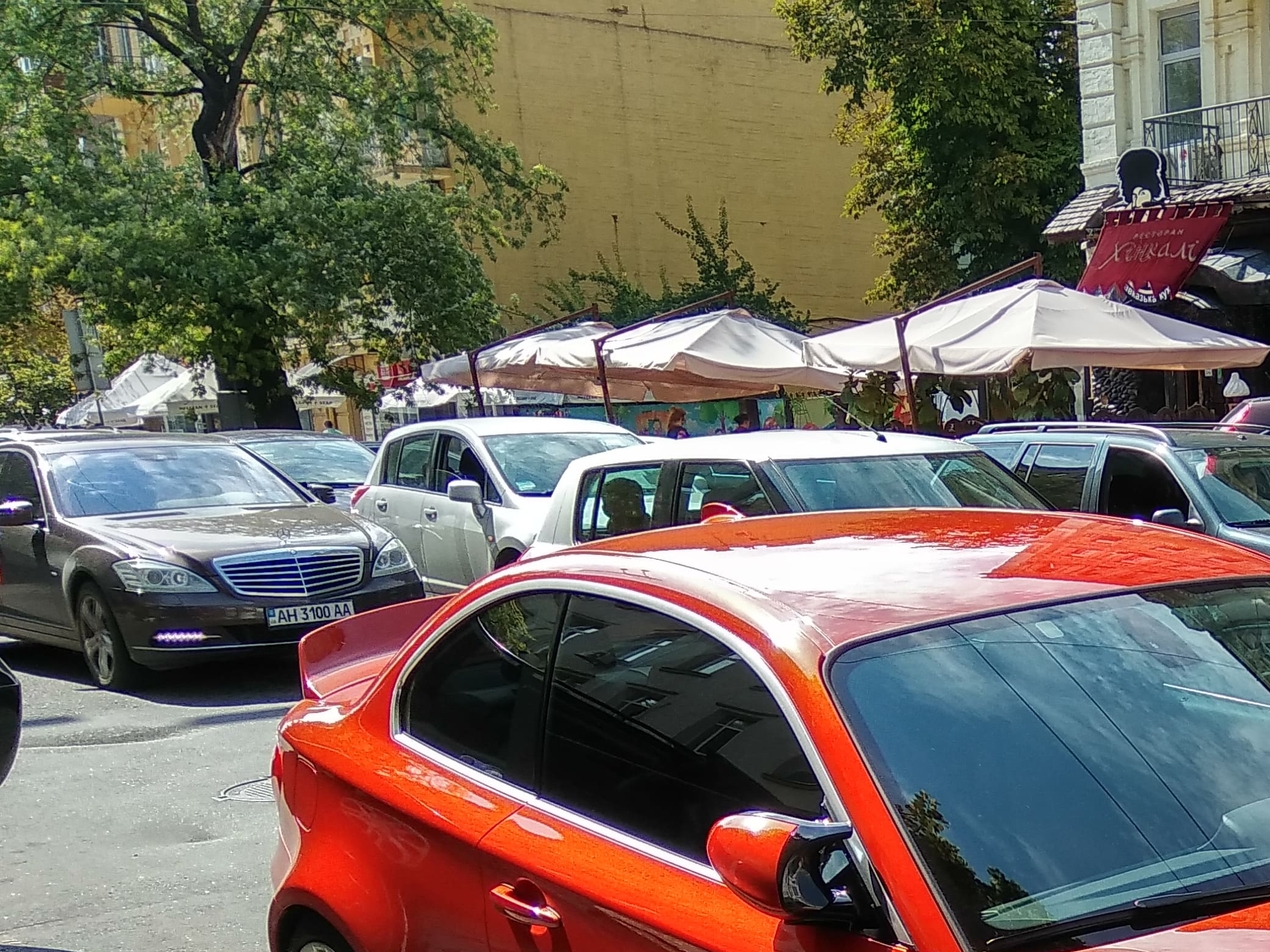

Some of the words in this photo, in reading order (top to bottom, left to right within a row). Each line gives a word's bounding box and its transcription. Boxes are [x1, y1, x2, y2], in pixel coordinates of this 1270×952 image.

[278, 608, 298, 623] AH
[301, 605, 330, 620] 3100
[334, 603, 352, 617] AA
